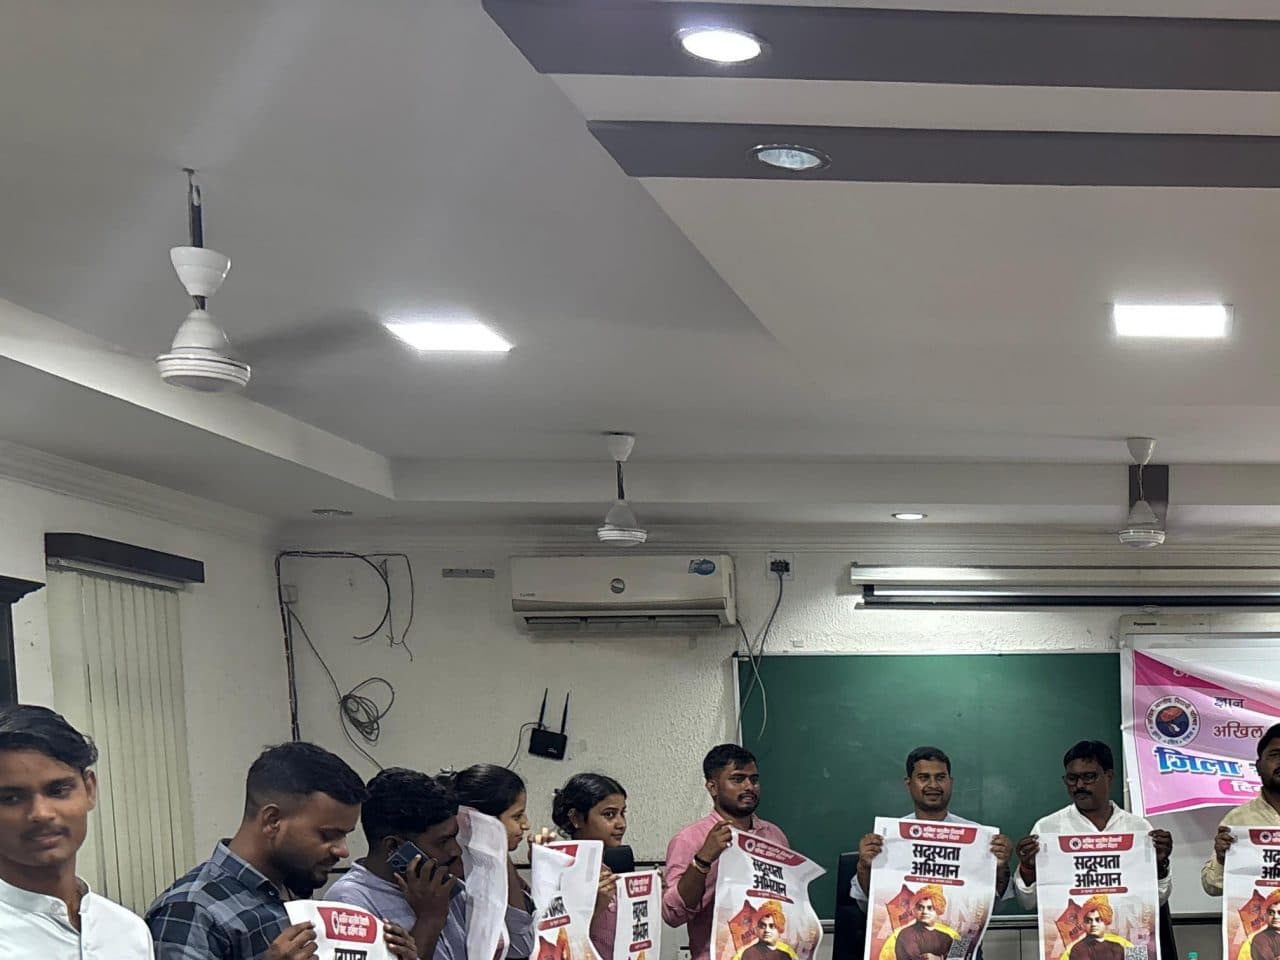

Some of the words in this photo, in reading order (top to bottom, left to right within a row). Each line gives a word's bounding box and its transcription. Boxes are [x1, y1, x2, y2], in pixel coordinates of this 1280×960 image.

[1212, 720, 1263, 739] अखिल
[1155, 746, 1243, 777] जिला
[912, 843, 961, 861] सदस्यता
[910, 858, 961, 878] अभियान
[1073, 855, 1121, 870] सदस्यता
[1074, 869, 1122, 888] अभियान
